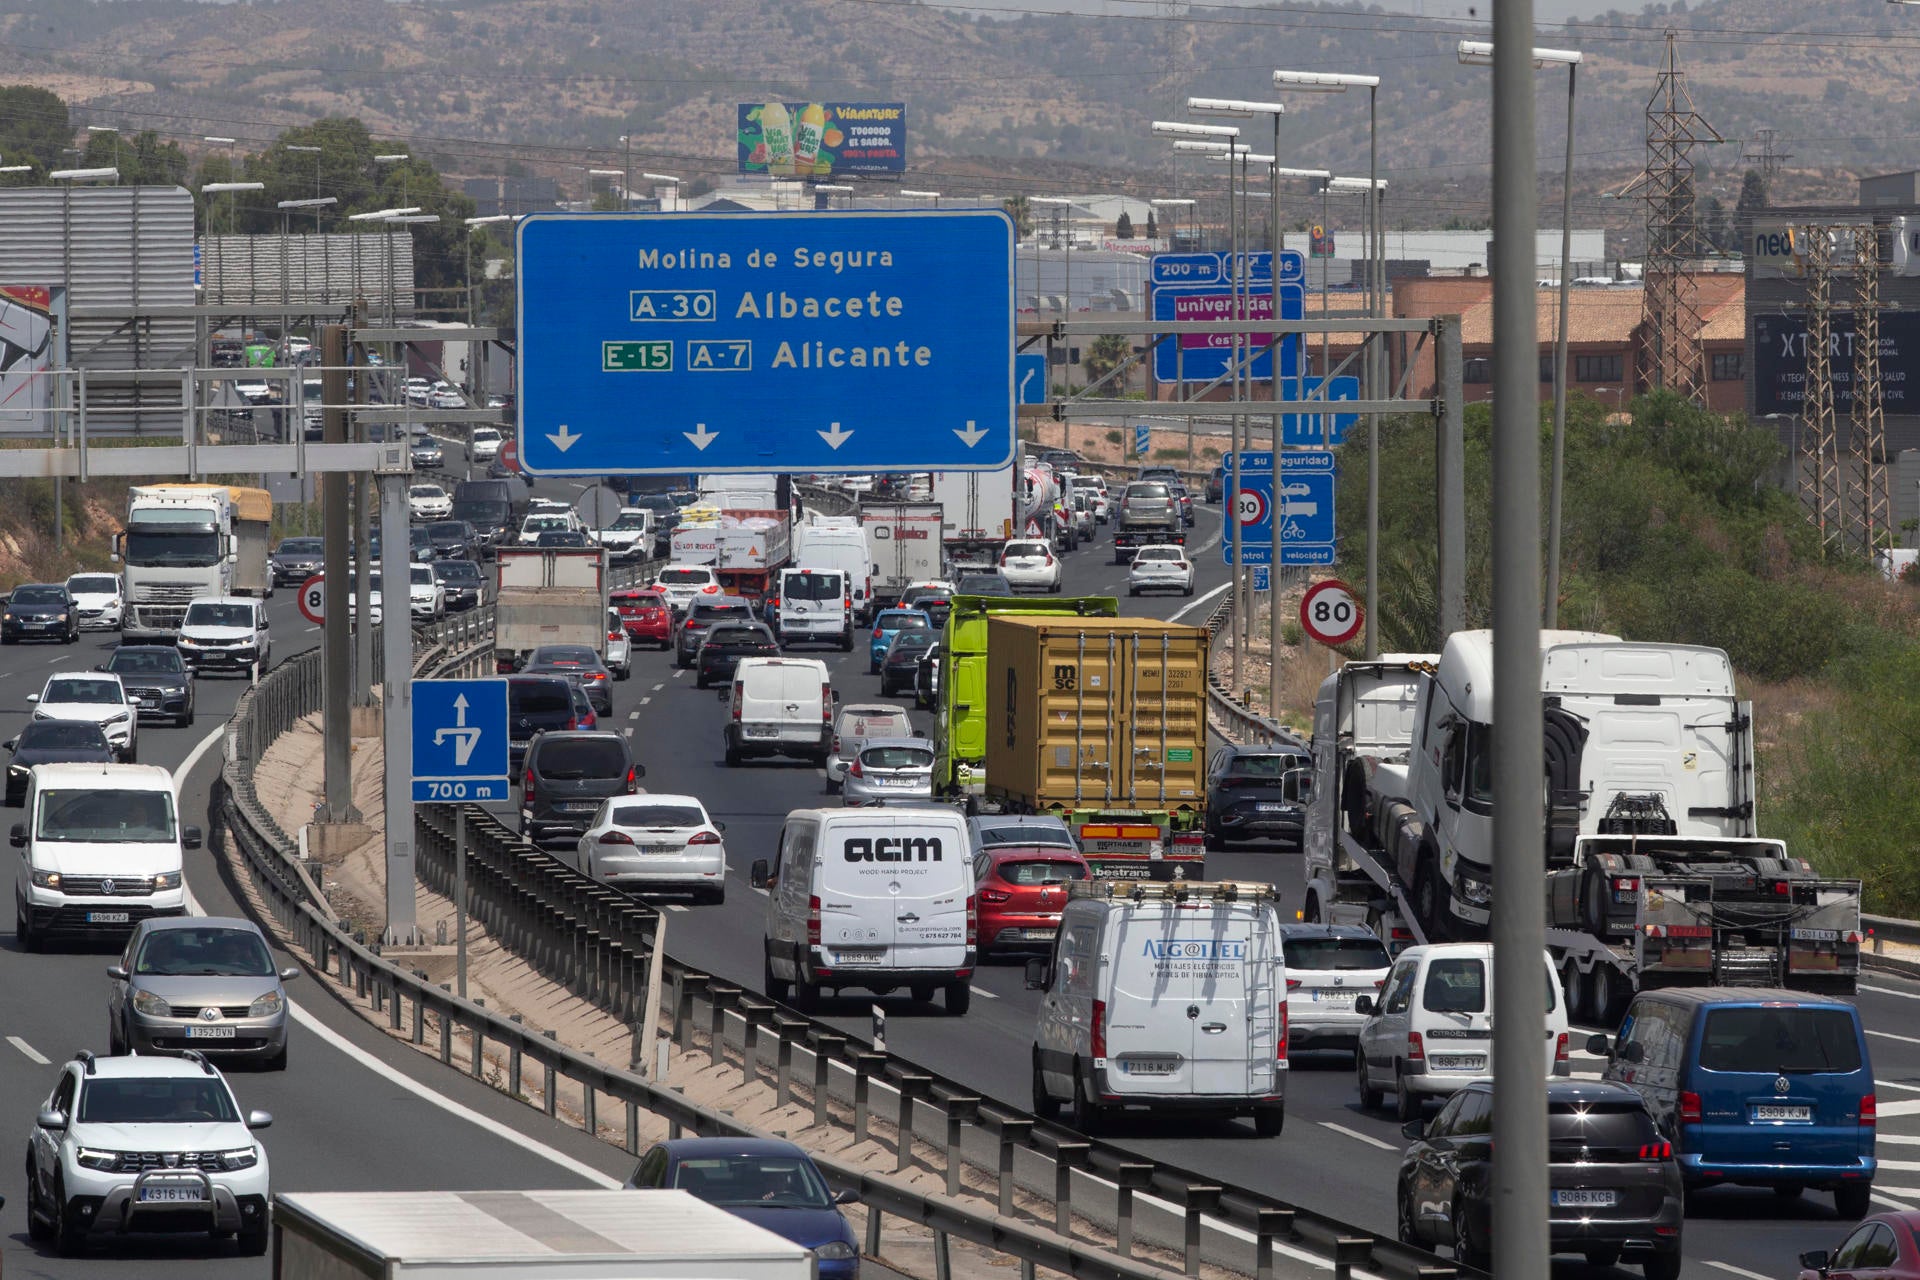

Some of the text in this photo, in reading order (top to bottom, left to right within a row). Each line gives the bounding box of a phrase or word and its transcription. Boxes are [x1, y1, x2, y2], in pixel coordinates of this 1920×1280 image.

[638, 248, 894, 274] Molina de Segura
[1161, 264, 1211, 276] 200 m
[635, 290, 904, 319] A-30 Albacete
[606, 340, 933, 368] E-15 A-7 Alicante
[1253, 457, 1268, 466] su
[1280, 455, 1329, 467] eguridad
[1286, 551, 1329, 560] velocidad
[309, 590, 322, 608] 8
[1315, 601, 1351, 622] 80
[428, 782, 491, 799] 700 m
[843, 837, 943, 863] acm
[1611, 922, 1635, 930] RENAUL
[1192, 971, 1213, 979] FIBRA
[193, 1027, 214, 1037] 1352
[1129, 1062, 1176, 1072] 7118 MJR
[1759, 1108, 1808, 1118] 5908 KJM
[148, 1188, 200, 1200] 4316 LVN
[1560, 1191, 1588, 1202] 9086
